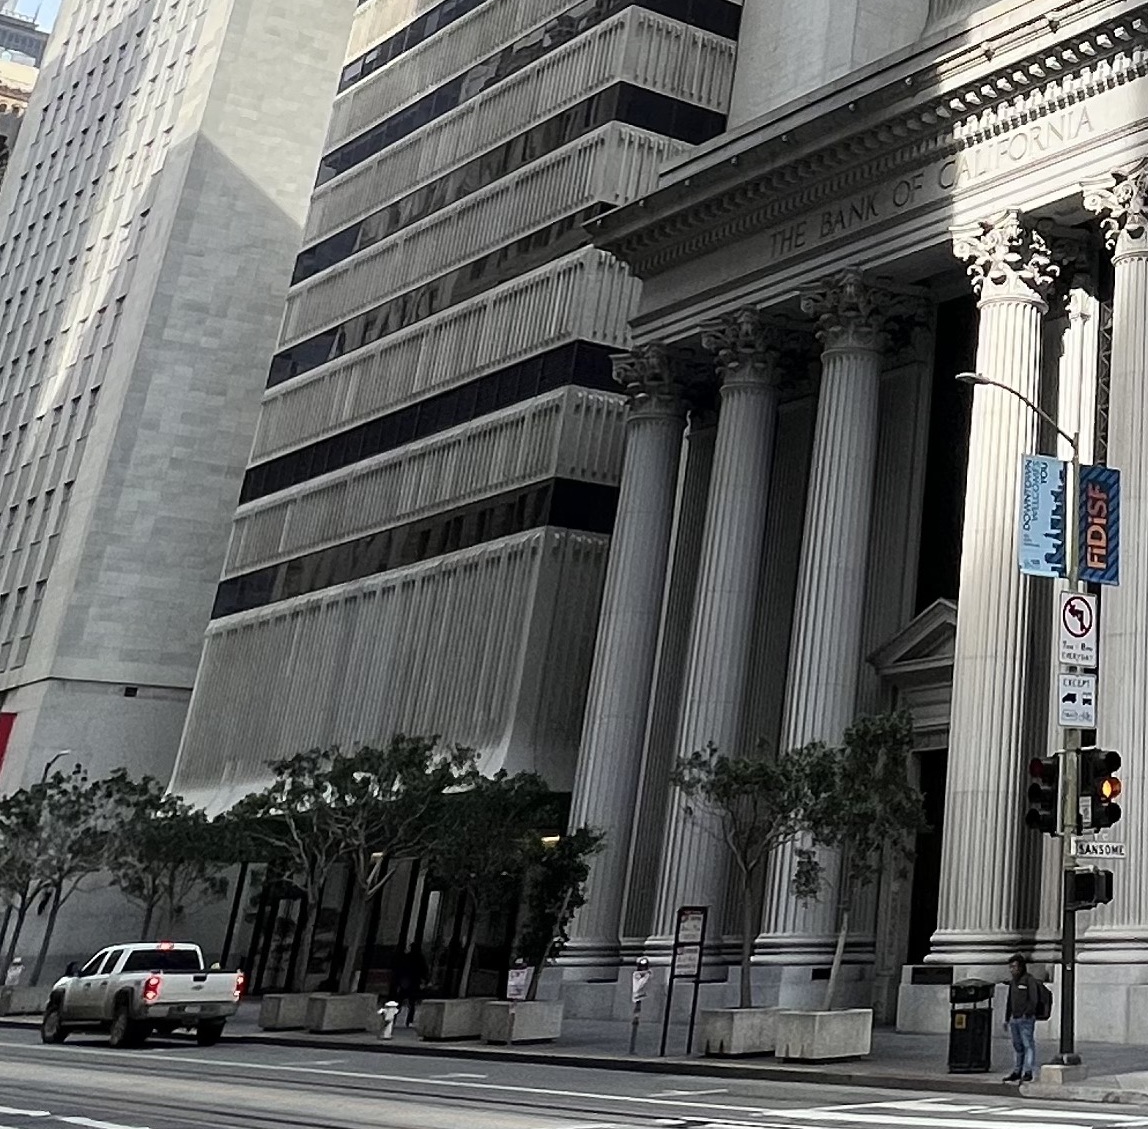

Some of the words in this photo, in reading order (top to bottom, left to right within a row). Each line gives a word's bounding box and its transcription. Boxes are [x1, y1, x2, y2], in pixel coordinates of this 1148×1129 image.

[770, 221, 806, 259] THE
[819, 191, 879, 239] BANK
[892, 172, 925, 207] OF
[938, 105, 1095, 190] CALIFORNIA
[1022, 459, 1032, 531] DOWNTOWN
[1040, 462, 1048, 484] YOU
[1078, 844, 1125, 856] SANSOME
